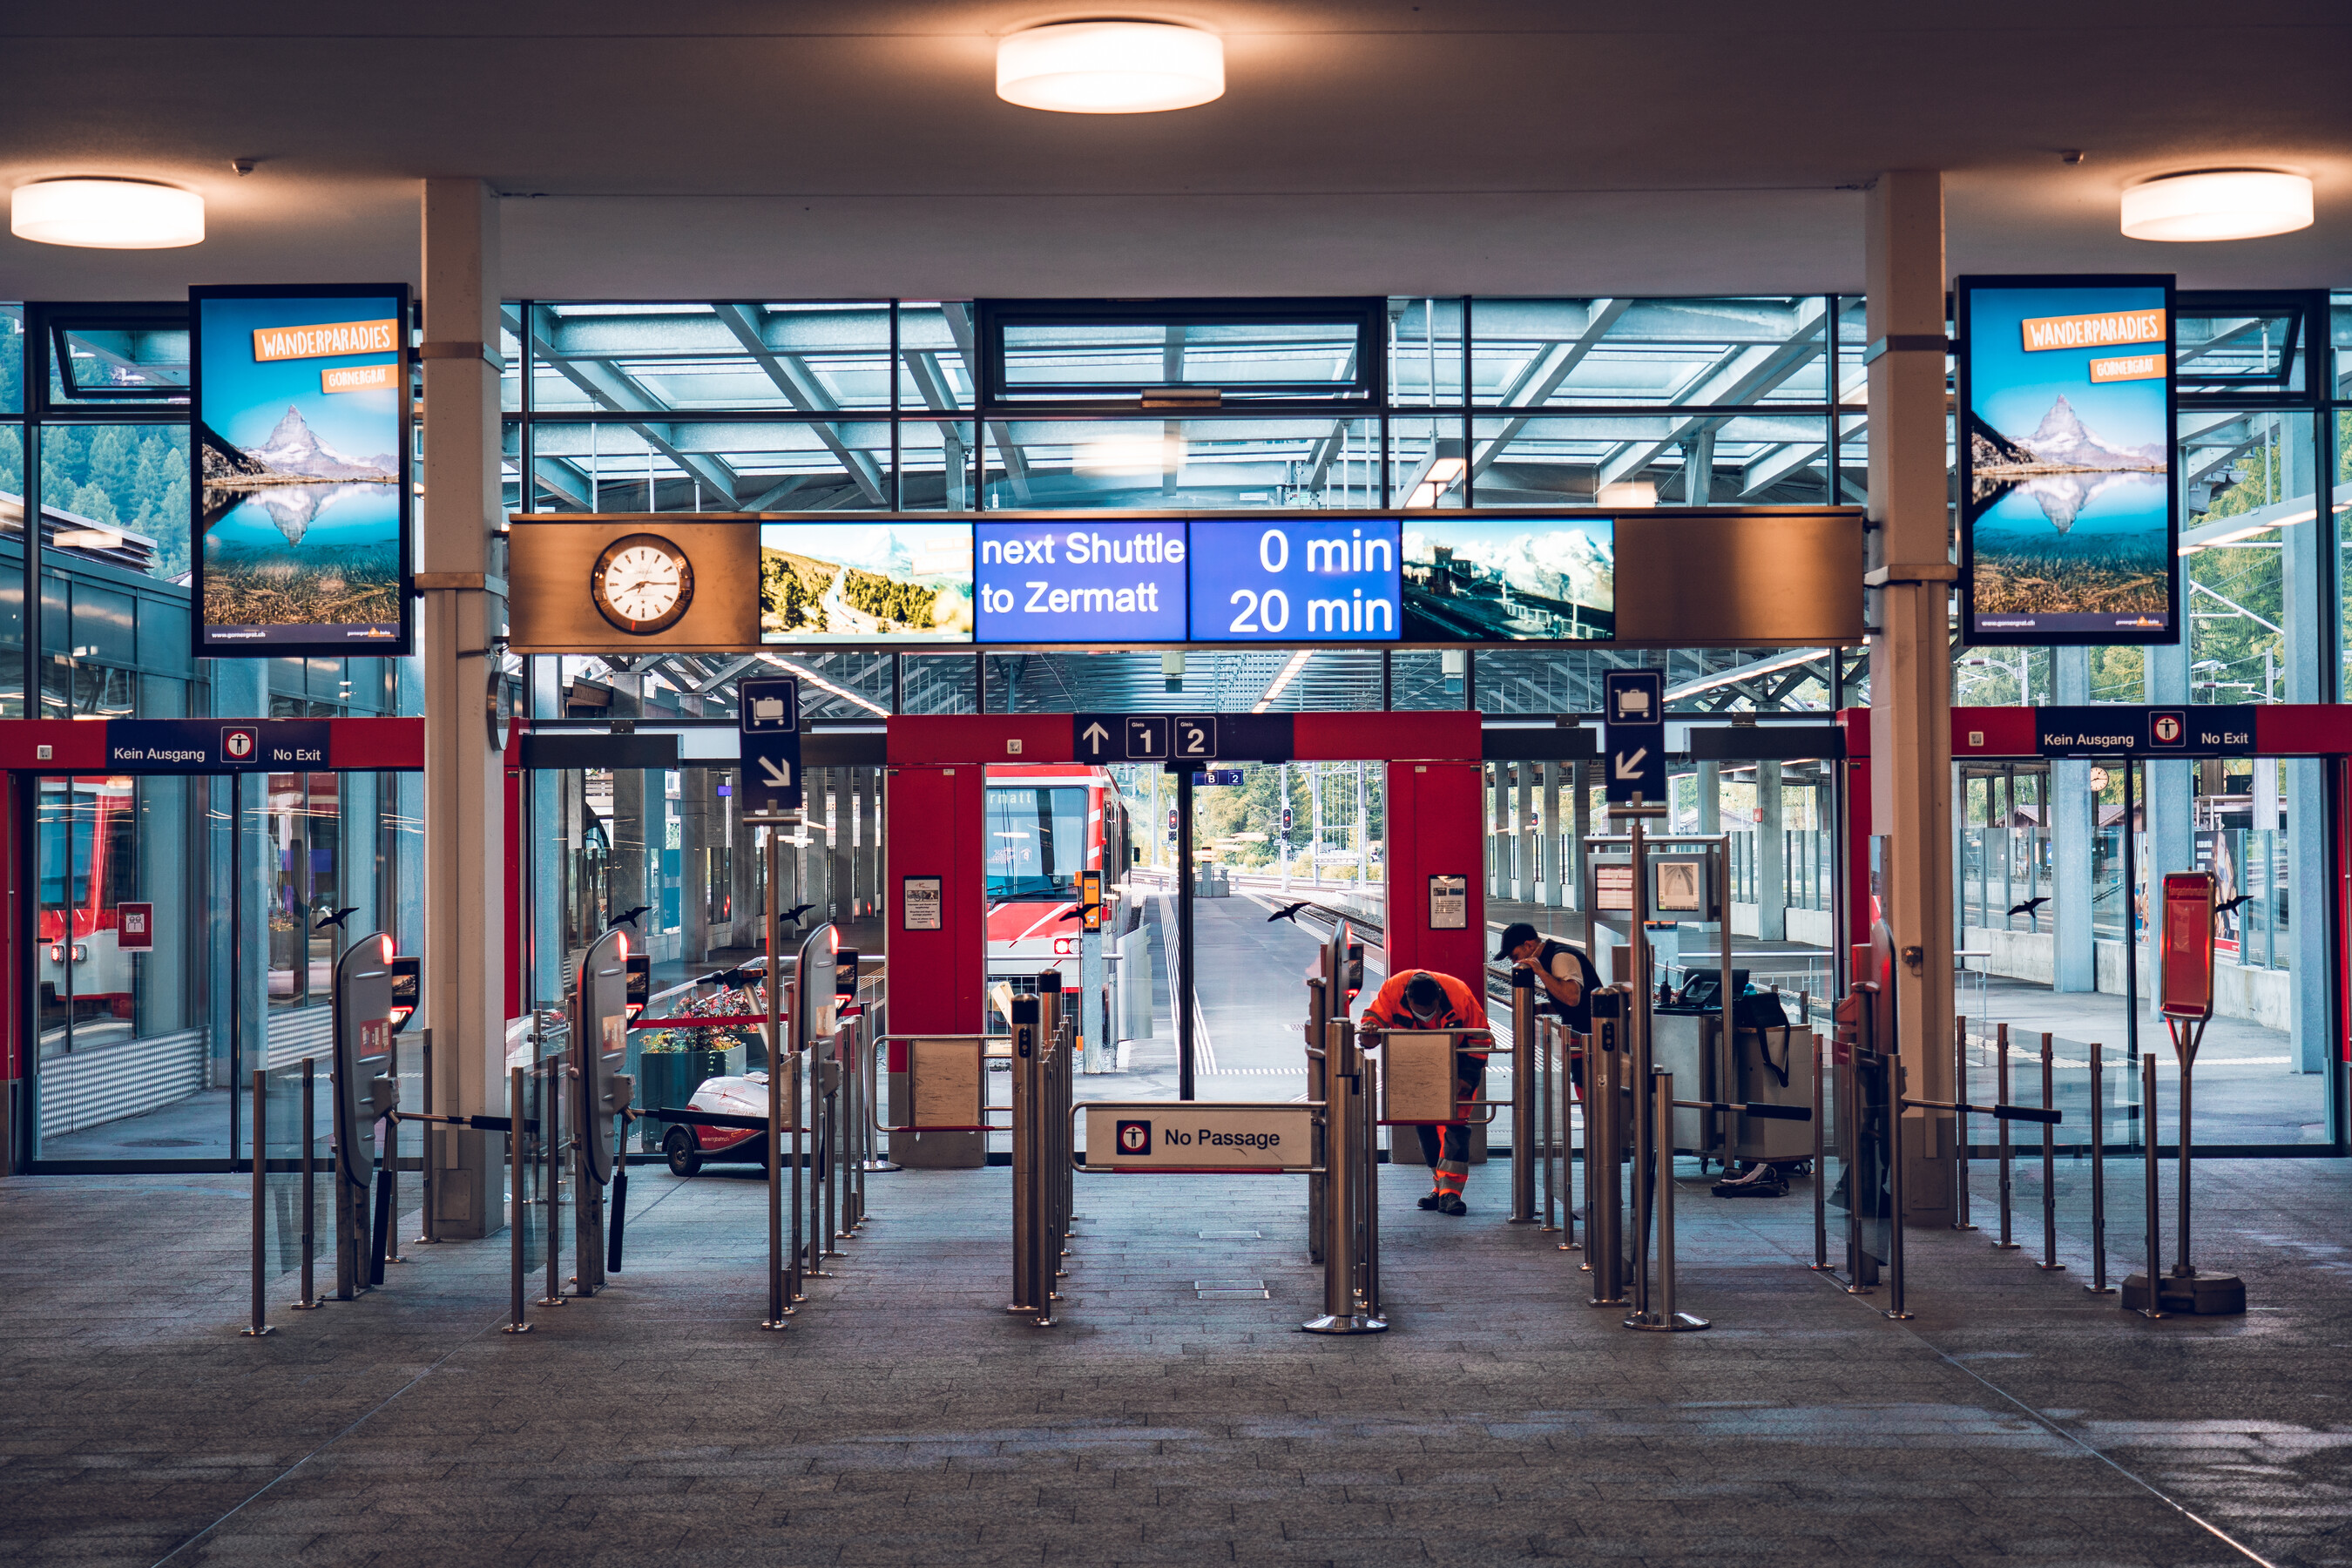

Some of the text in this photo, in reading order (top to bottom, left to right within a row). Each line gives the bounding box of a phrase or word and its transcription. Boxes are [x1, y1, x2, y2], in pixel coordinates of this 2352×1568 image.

[2030, 314, 2159, 348] WANDERPARADIES
[261, 325, 391, 358] WANDERPARADIES
[2096, 359, 2154, 376] GORNERGRAT
[328, 369, 387, 388] GORNERGRAT
[982, 533, 1056, 564] next
[1065, 531, 1186, 564] Shuttle
[1259, 528, 1392, 573] 0 min
[981, 581, 1159, 613] to Zermatt
[1229, 588, 1393, 633] 20 min
[1139, 729, 1152, 754] 1
[1186, 728, 1205, 753] 2
[2044, 733, 2134, 747] Kein Ausgang
[2201, 732, 2249, 744] No Exit
[113, 747, 206, 763] Kein Ausgang
[274, 748, 321, 761] No Exit
[1208, 774, 1215, 783] B
[1232, 774, 1239, 783] 2
[990, 791, 1031, 804] rmatt
[1164, 1129, 1281, 1150] No Passage
